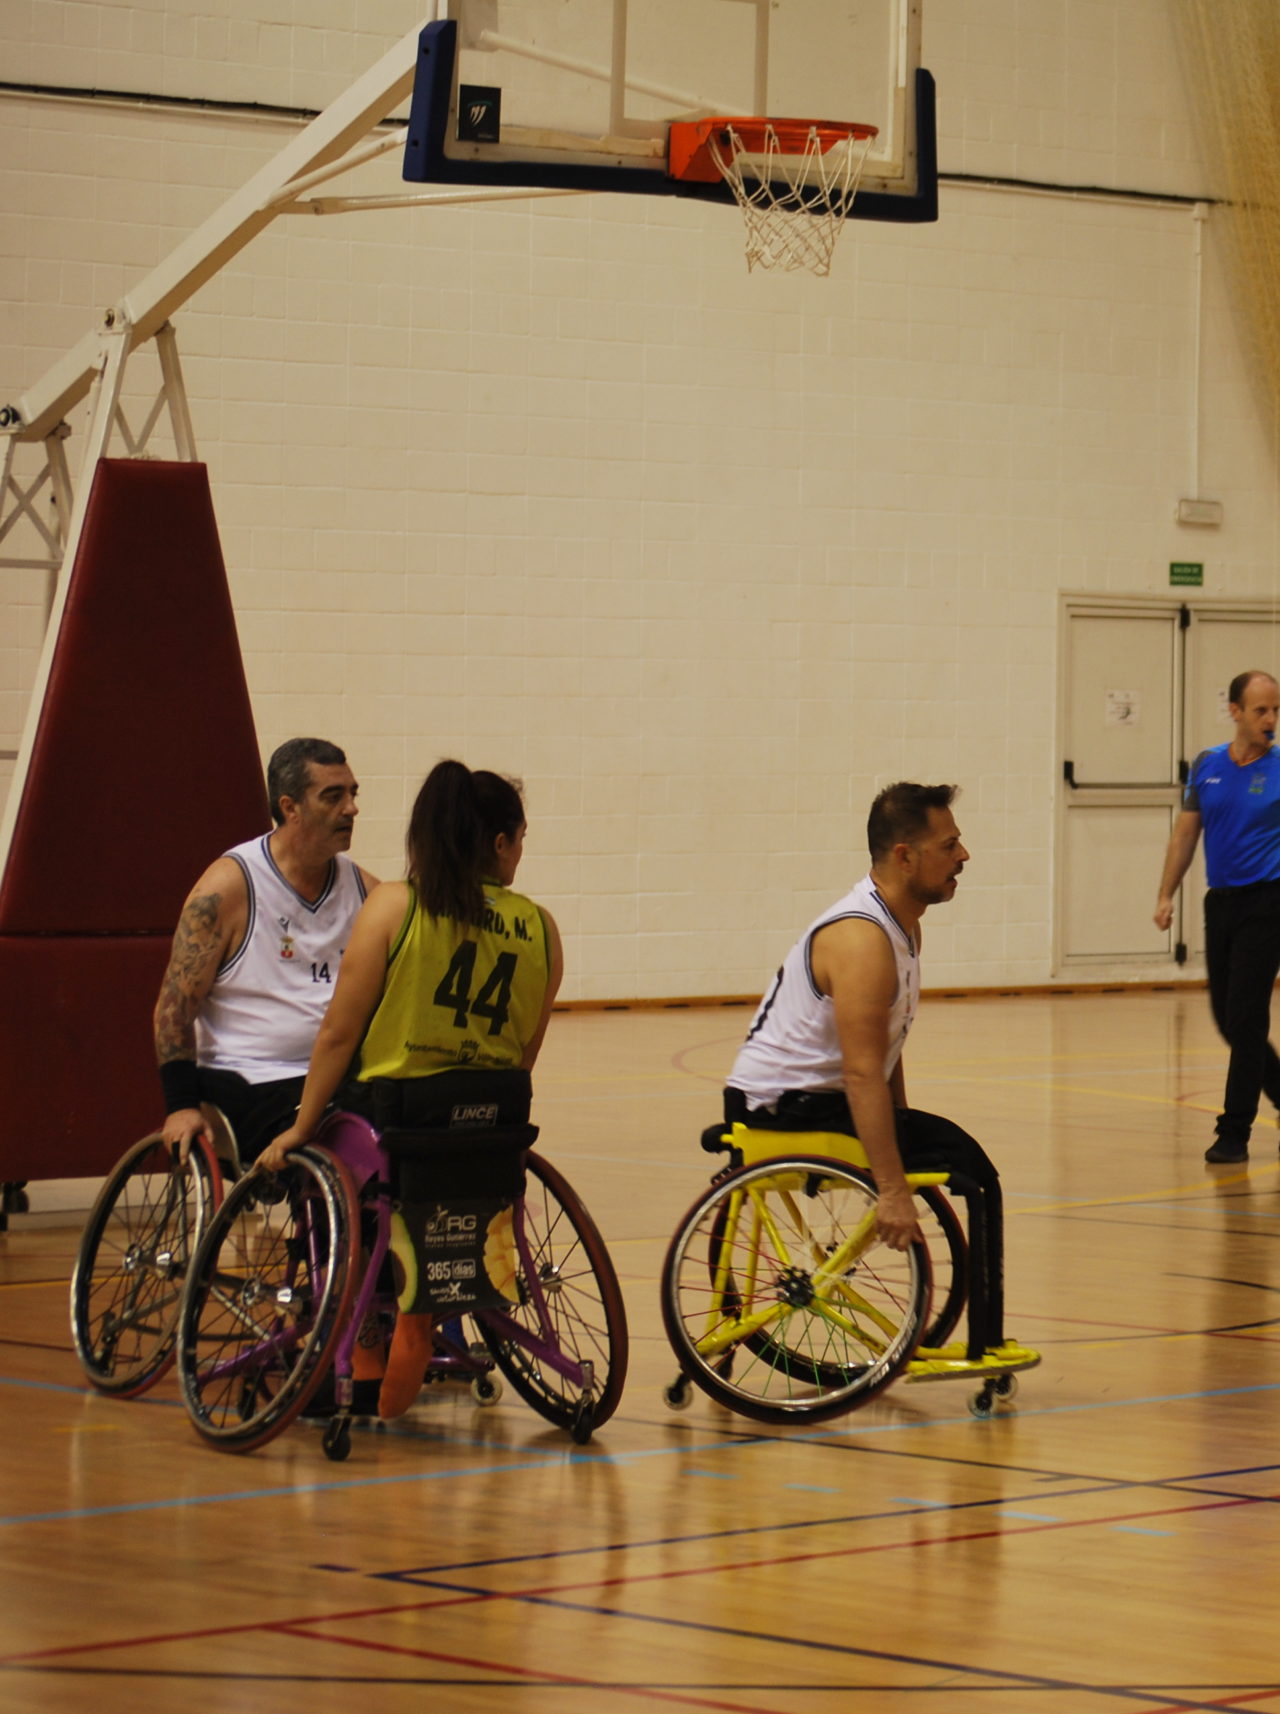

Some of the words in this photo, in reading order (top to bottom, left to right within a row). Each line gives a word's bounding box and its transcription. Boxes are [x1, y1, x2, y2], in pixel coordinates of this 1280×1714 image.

[310, 961, 332, 984] 14
[433, 939, 518, 1036] 44
[453, 1106, 497, 1120] LINCE
[448, 1214, 477, 1231] RG
[427, 1261, 451, 1281] 365
